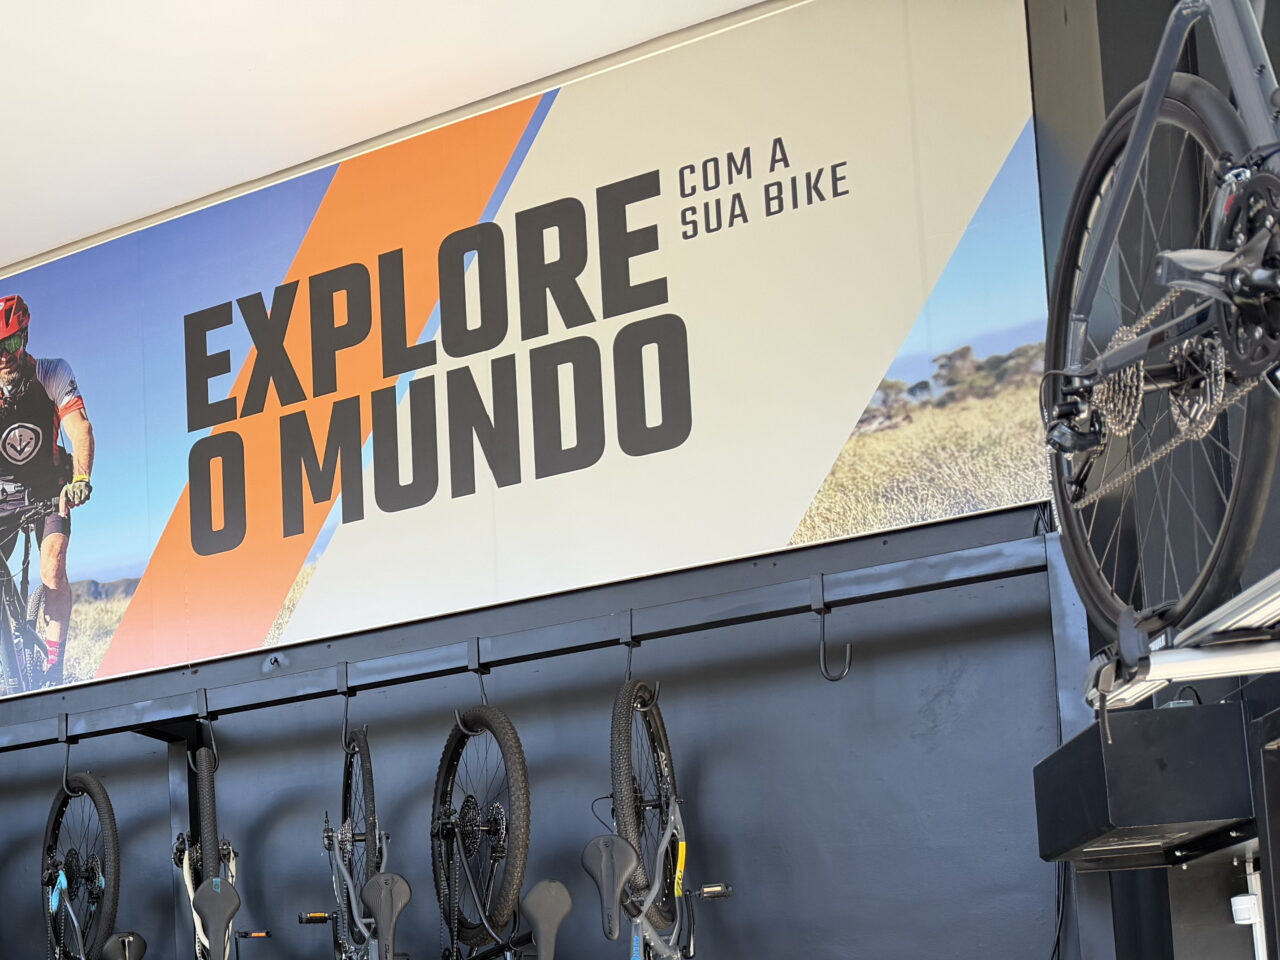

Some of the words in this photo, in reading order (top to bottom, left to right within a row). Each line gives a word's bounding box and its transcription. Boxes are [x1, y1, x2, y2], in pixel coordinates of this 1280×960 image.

[679, 146, 752, 199] COM
[769, 137, 790, 173] A
[681, 192, 749, 240] SUA
[763, 161, 850, 217] BIKE
[183, 169, 669, 433] EXPLORE
[188, 430, 247, 556] O
[279, 313, 693, 539] MUNDO
